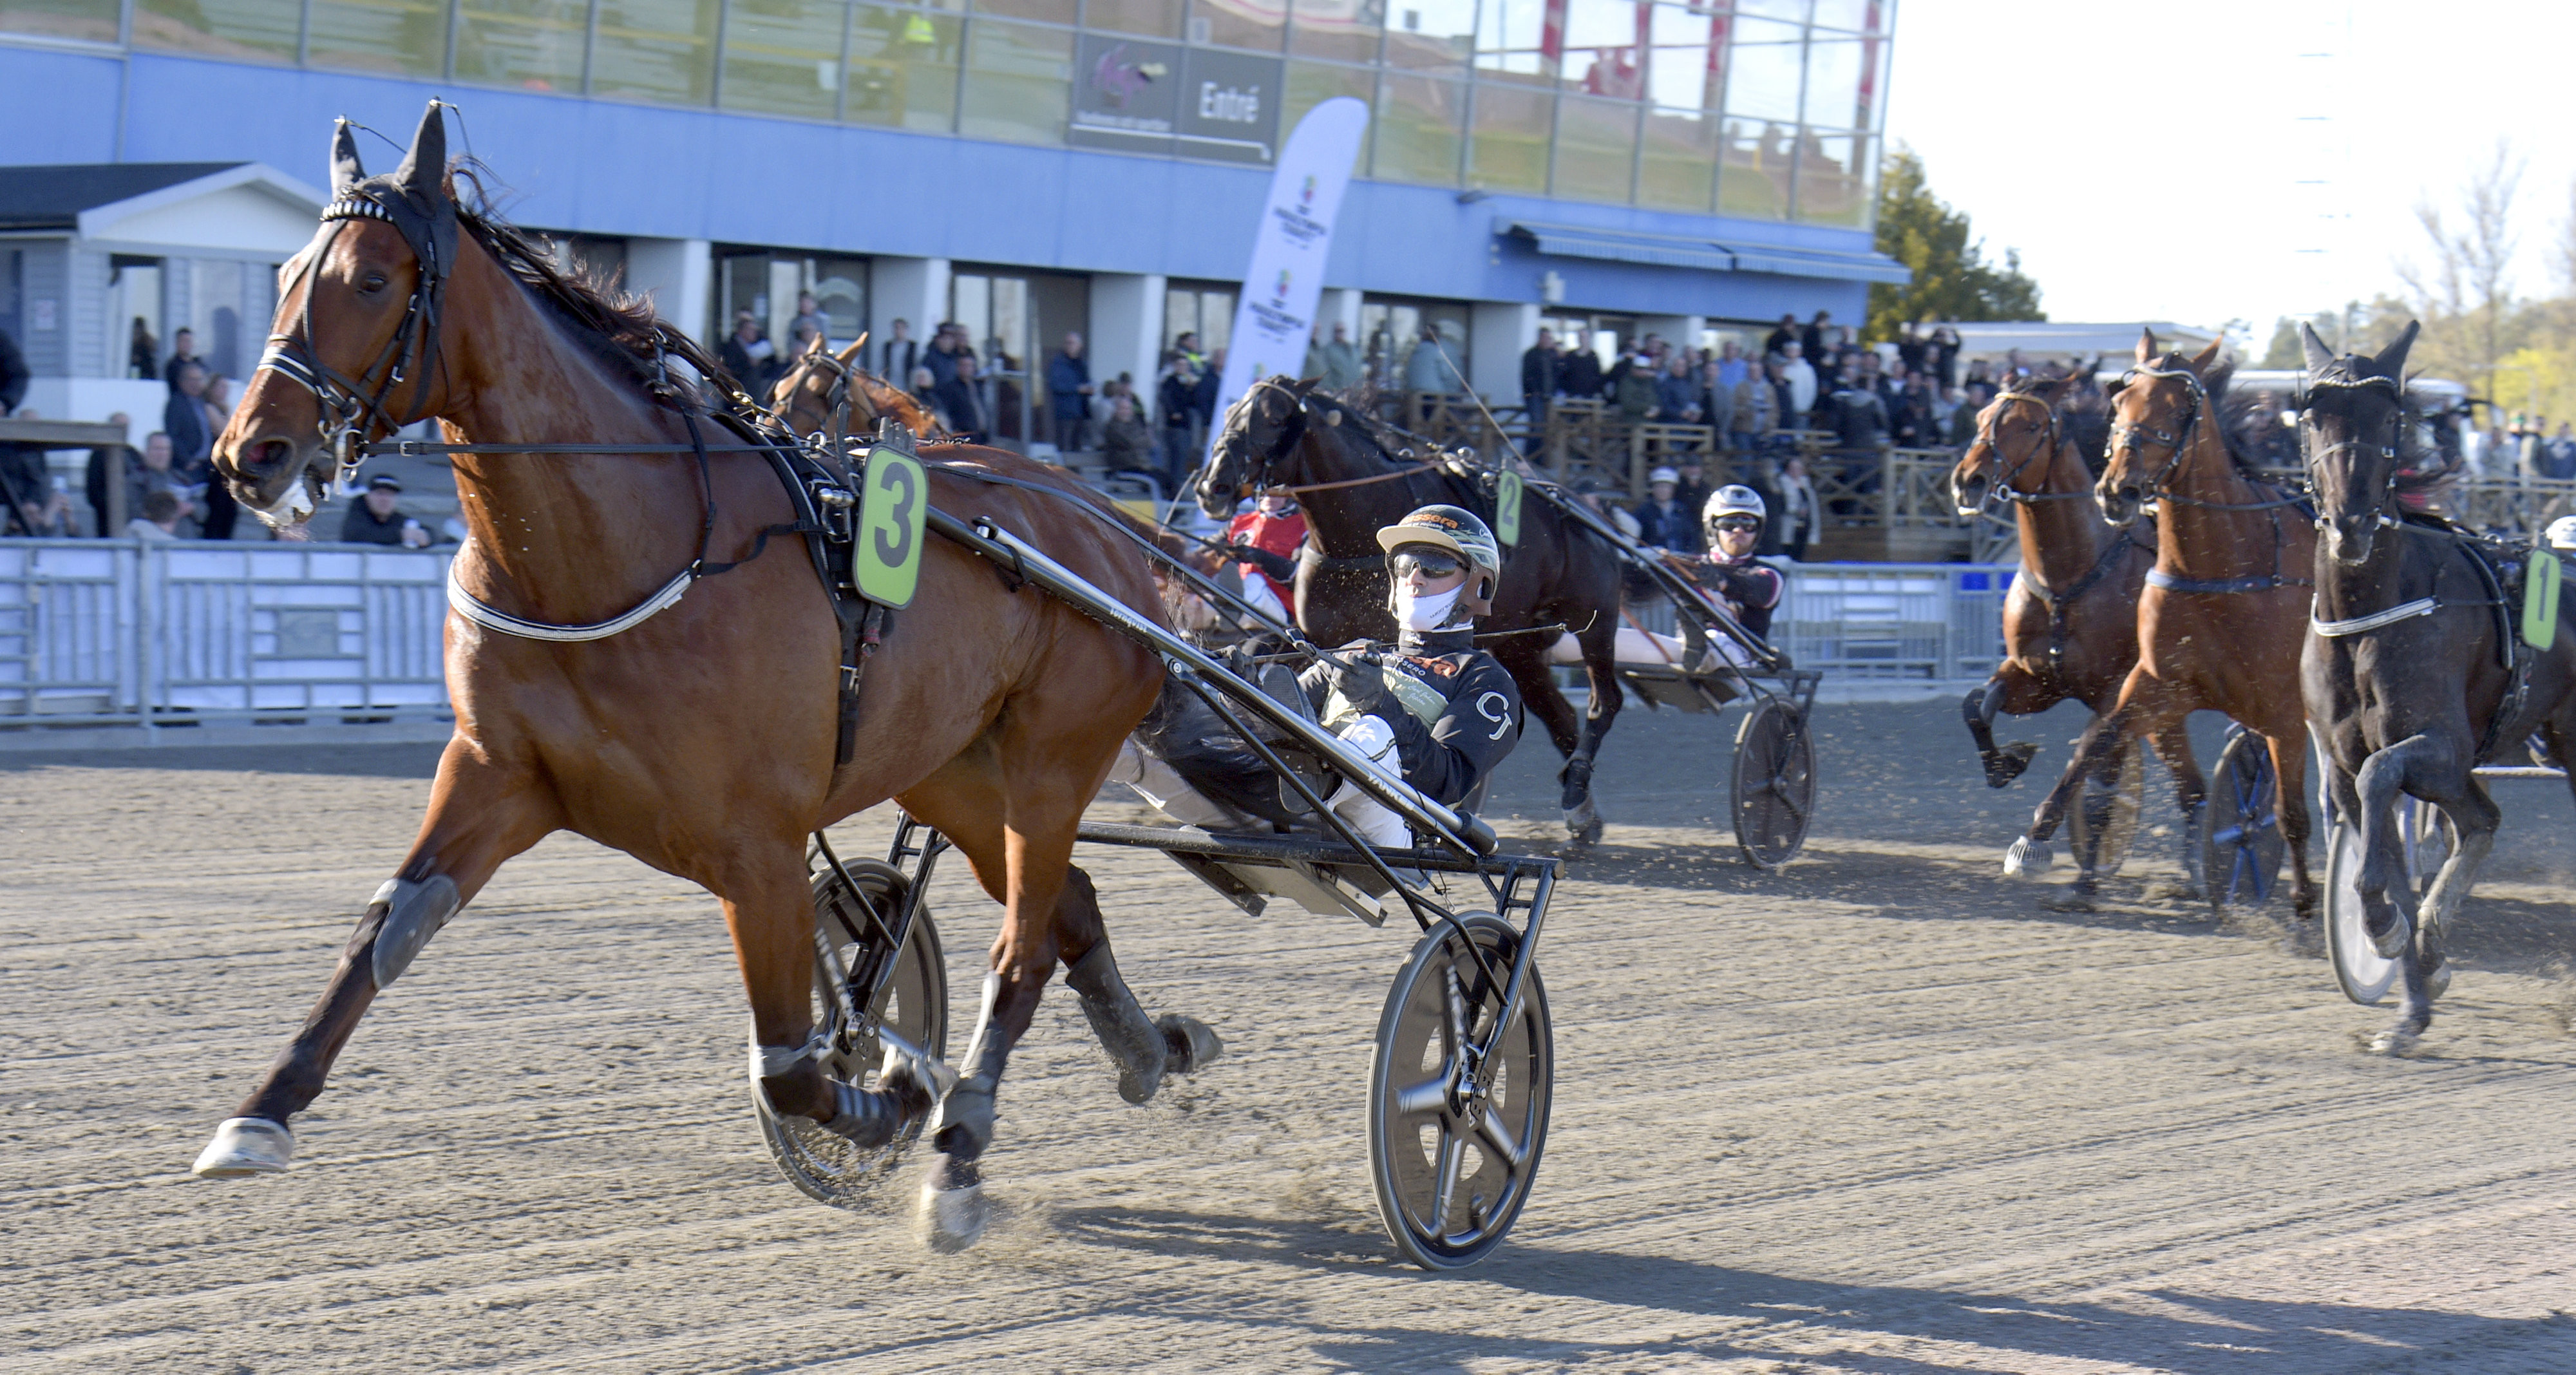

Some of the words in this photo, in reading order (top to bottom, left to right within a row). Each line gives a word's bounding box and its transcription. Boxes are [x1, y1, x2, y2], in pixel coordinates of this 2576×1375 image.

[1199, 81, 1260, 124] Entré
[875, 462, 914, 568] 3
[1502, 475, 1517, 527] 2
[2539, 558, 2550, 621] 1
[1384, 654, 1426, 676] PROSERO
[1367, 772, 1414, 811] YANKEE
